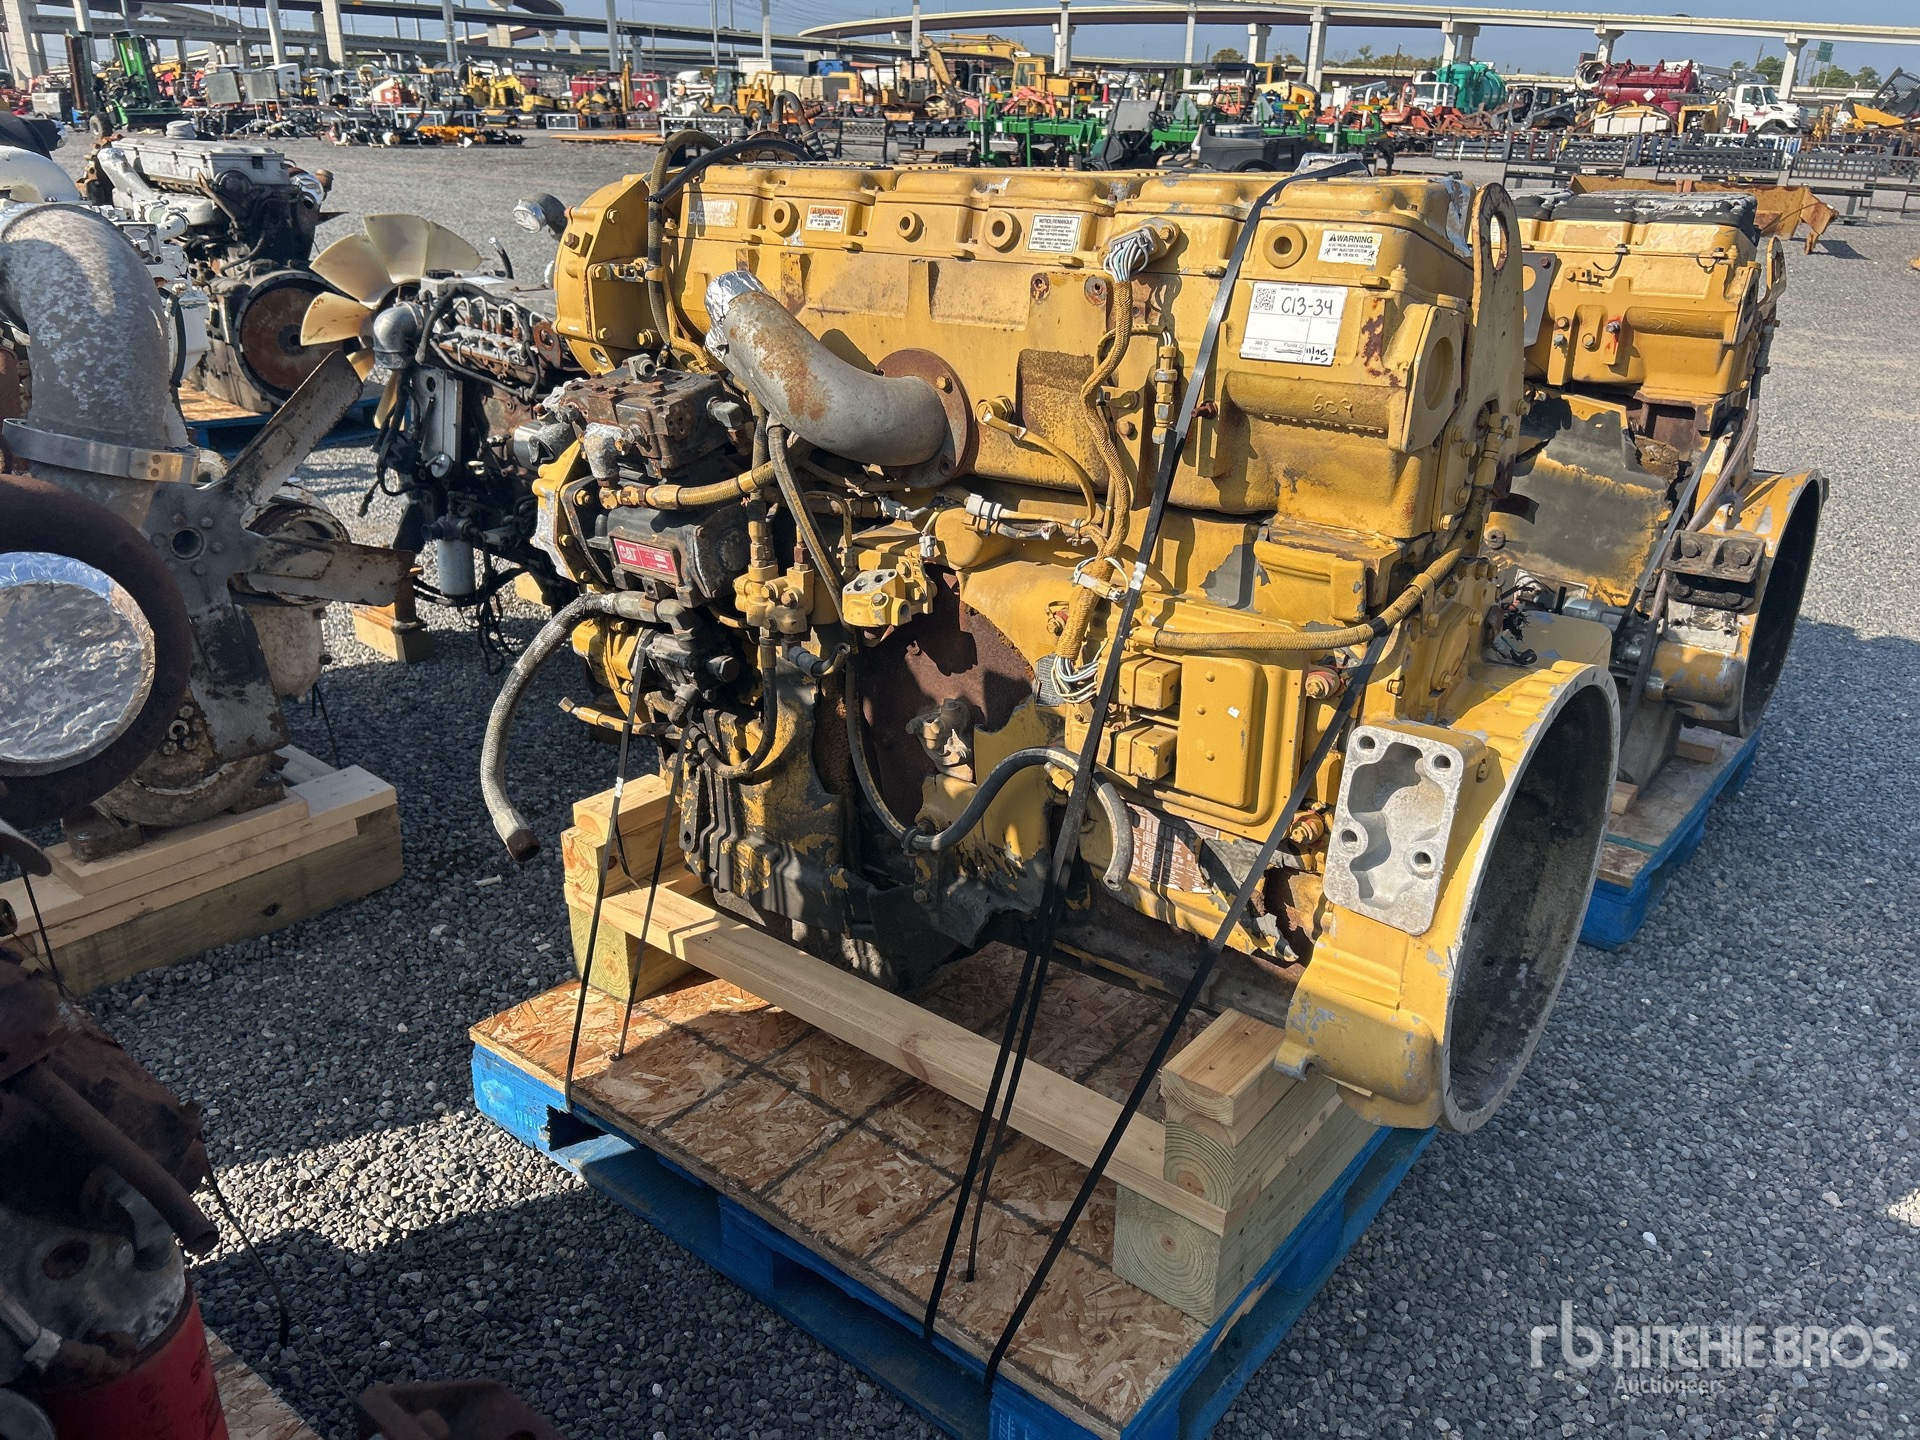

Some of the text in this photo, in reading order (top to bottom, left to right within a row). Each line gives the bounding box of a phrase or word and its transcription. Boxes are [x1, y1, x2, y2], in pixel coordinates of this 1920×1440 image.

[1337, 234, 1373, 244] WARNING
[1281, 296, 1334, 316] C13-34
[618, 545, 637, 561] CAT
